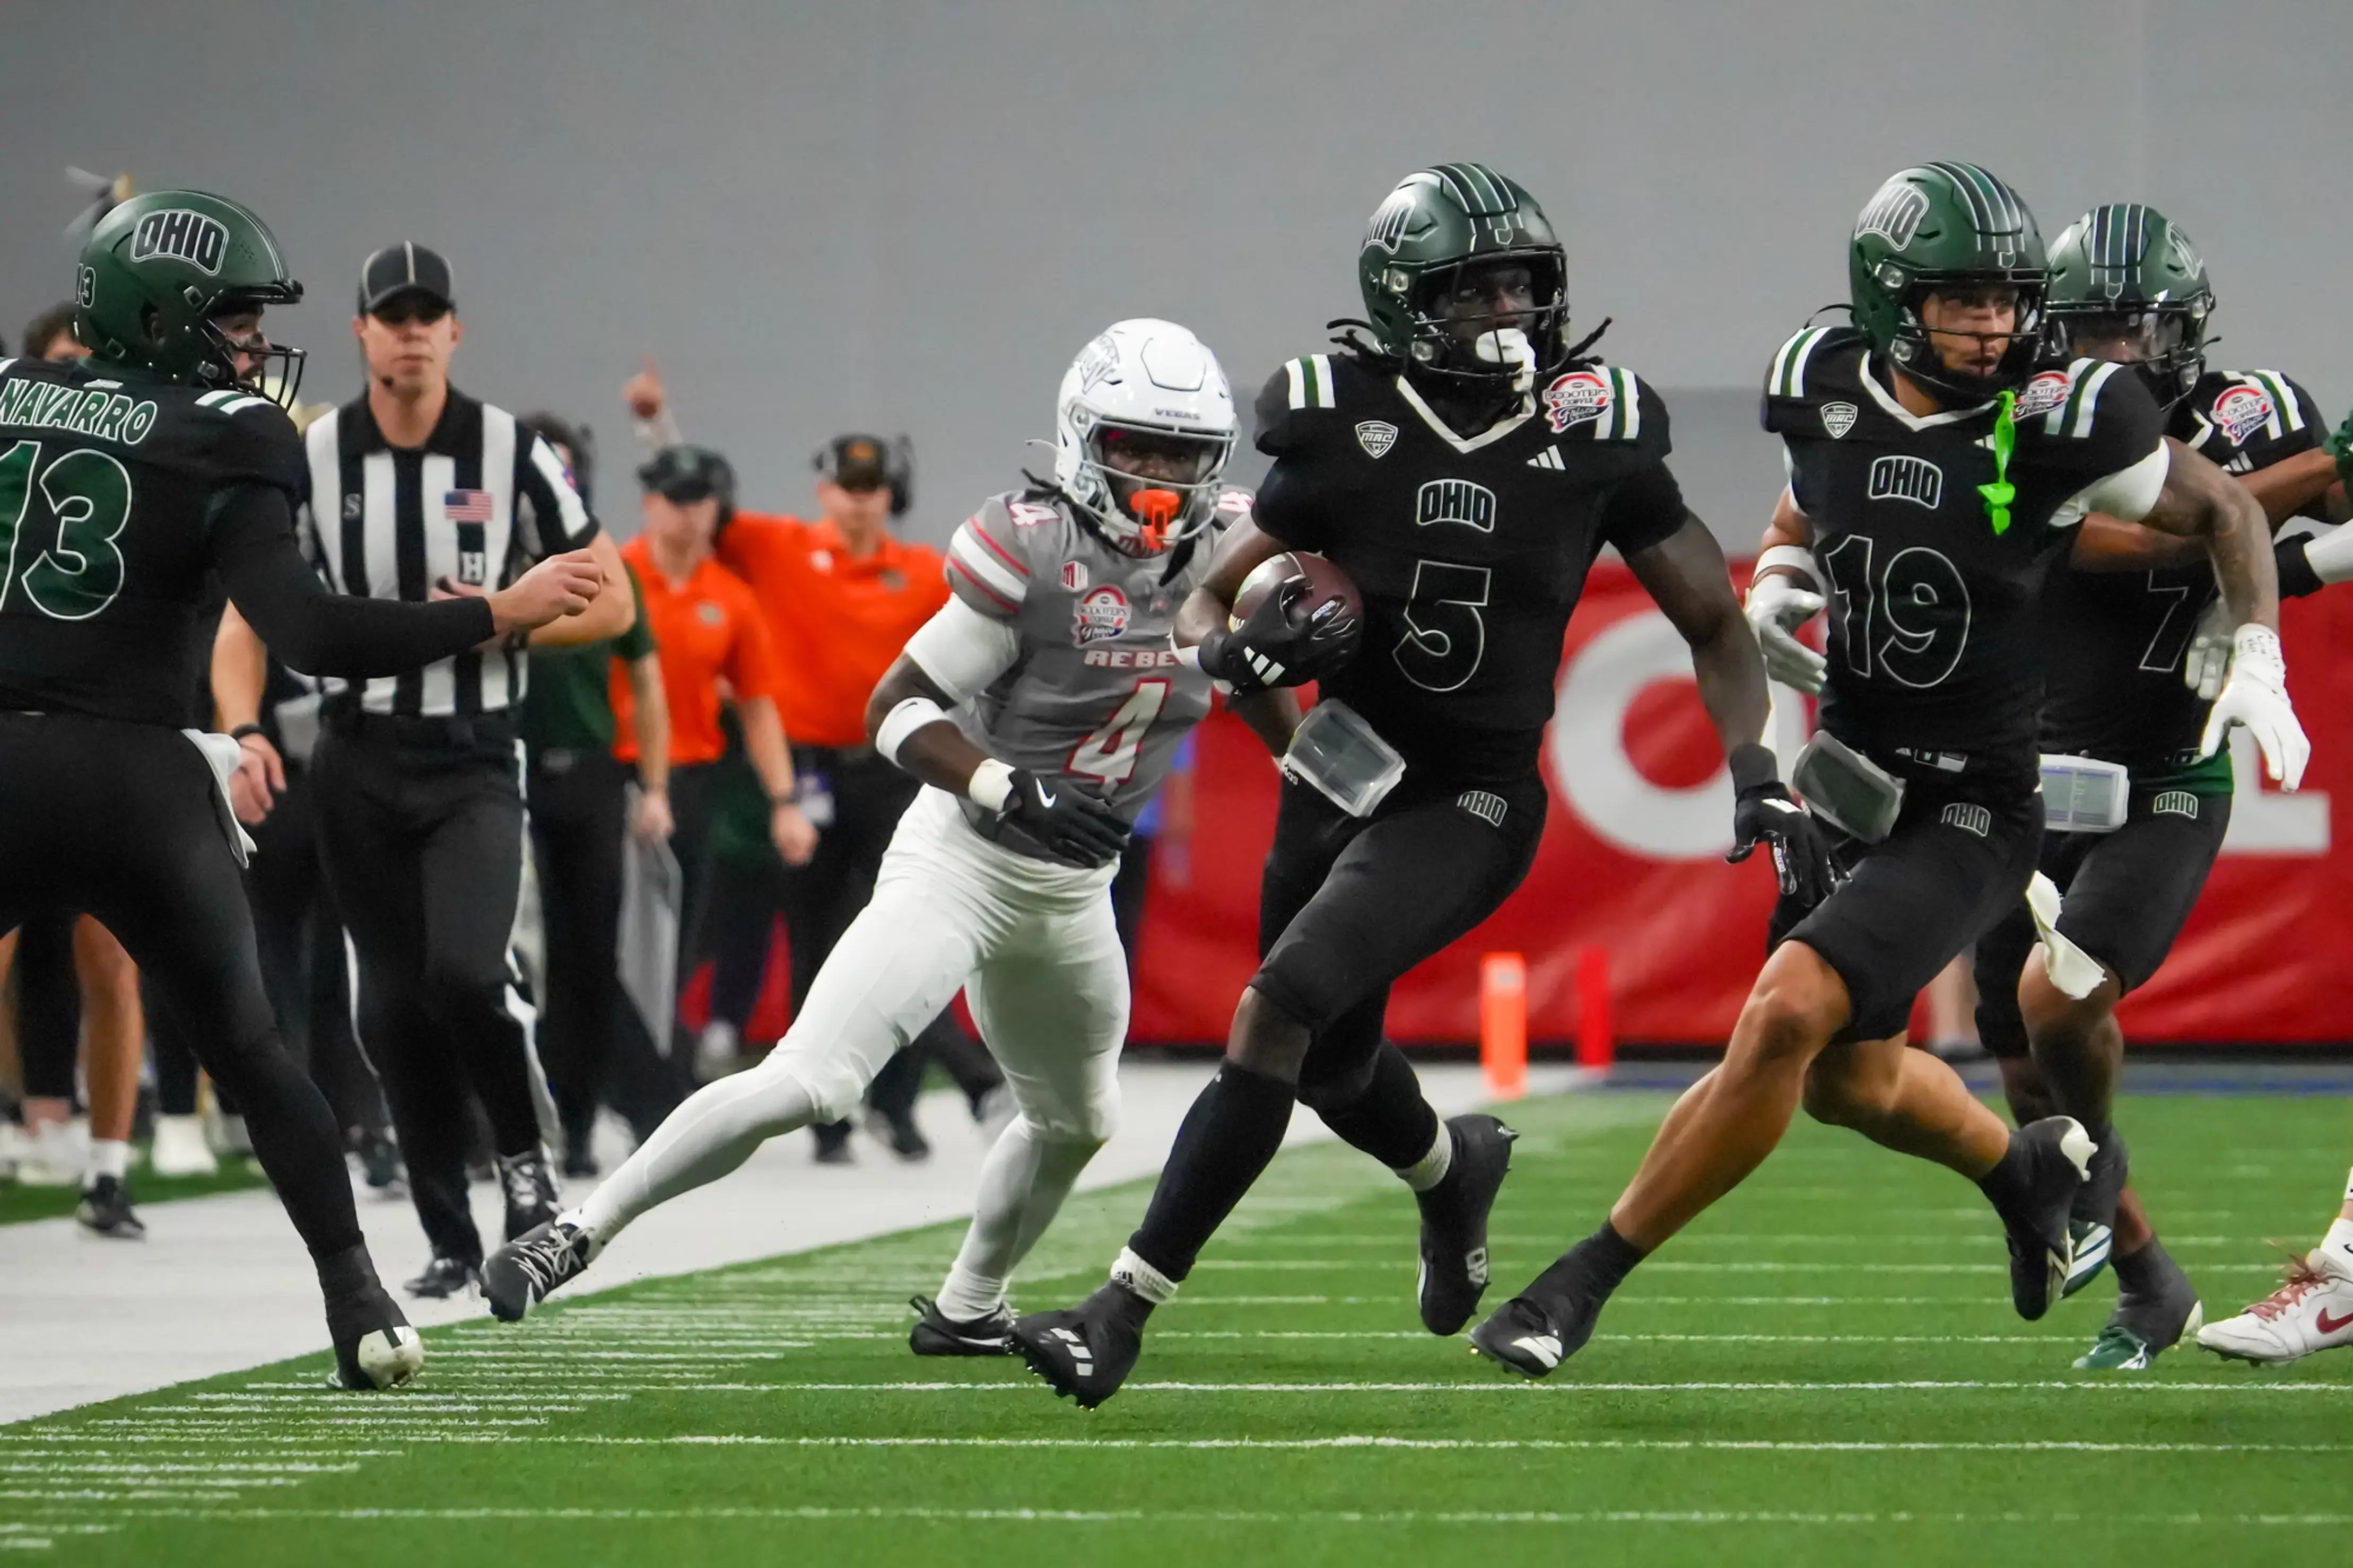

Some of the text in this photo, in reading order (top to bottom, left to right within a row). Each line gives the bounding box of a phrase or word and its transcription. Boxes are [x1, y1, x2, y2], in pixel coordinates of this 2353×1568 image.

[131, 209, 229, 276] OHIO
[0, 378, 158, 445] NAVARRO
[1155, 407, 1201, 421] VEGAS
[1417, 479, 1496, 533] OHIO
[1868, 454, 1942, 510] OHIO
[1392, 559, 1491, 692] 5
[1825, 535, 1972, 688] 19
[1084, 651, 1176, 668] REBE
[1062, 676, 1172, 785] 4
[1457, 790, 1507, 827] OHIO
[1940, 802, 1992, 837] OHIO
[2152, 790, 2199, 820] OHIO
